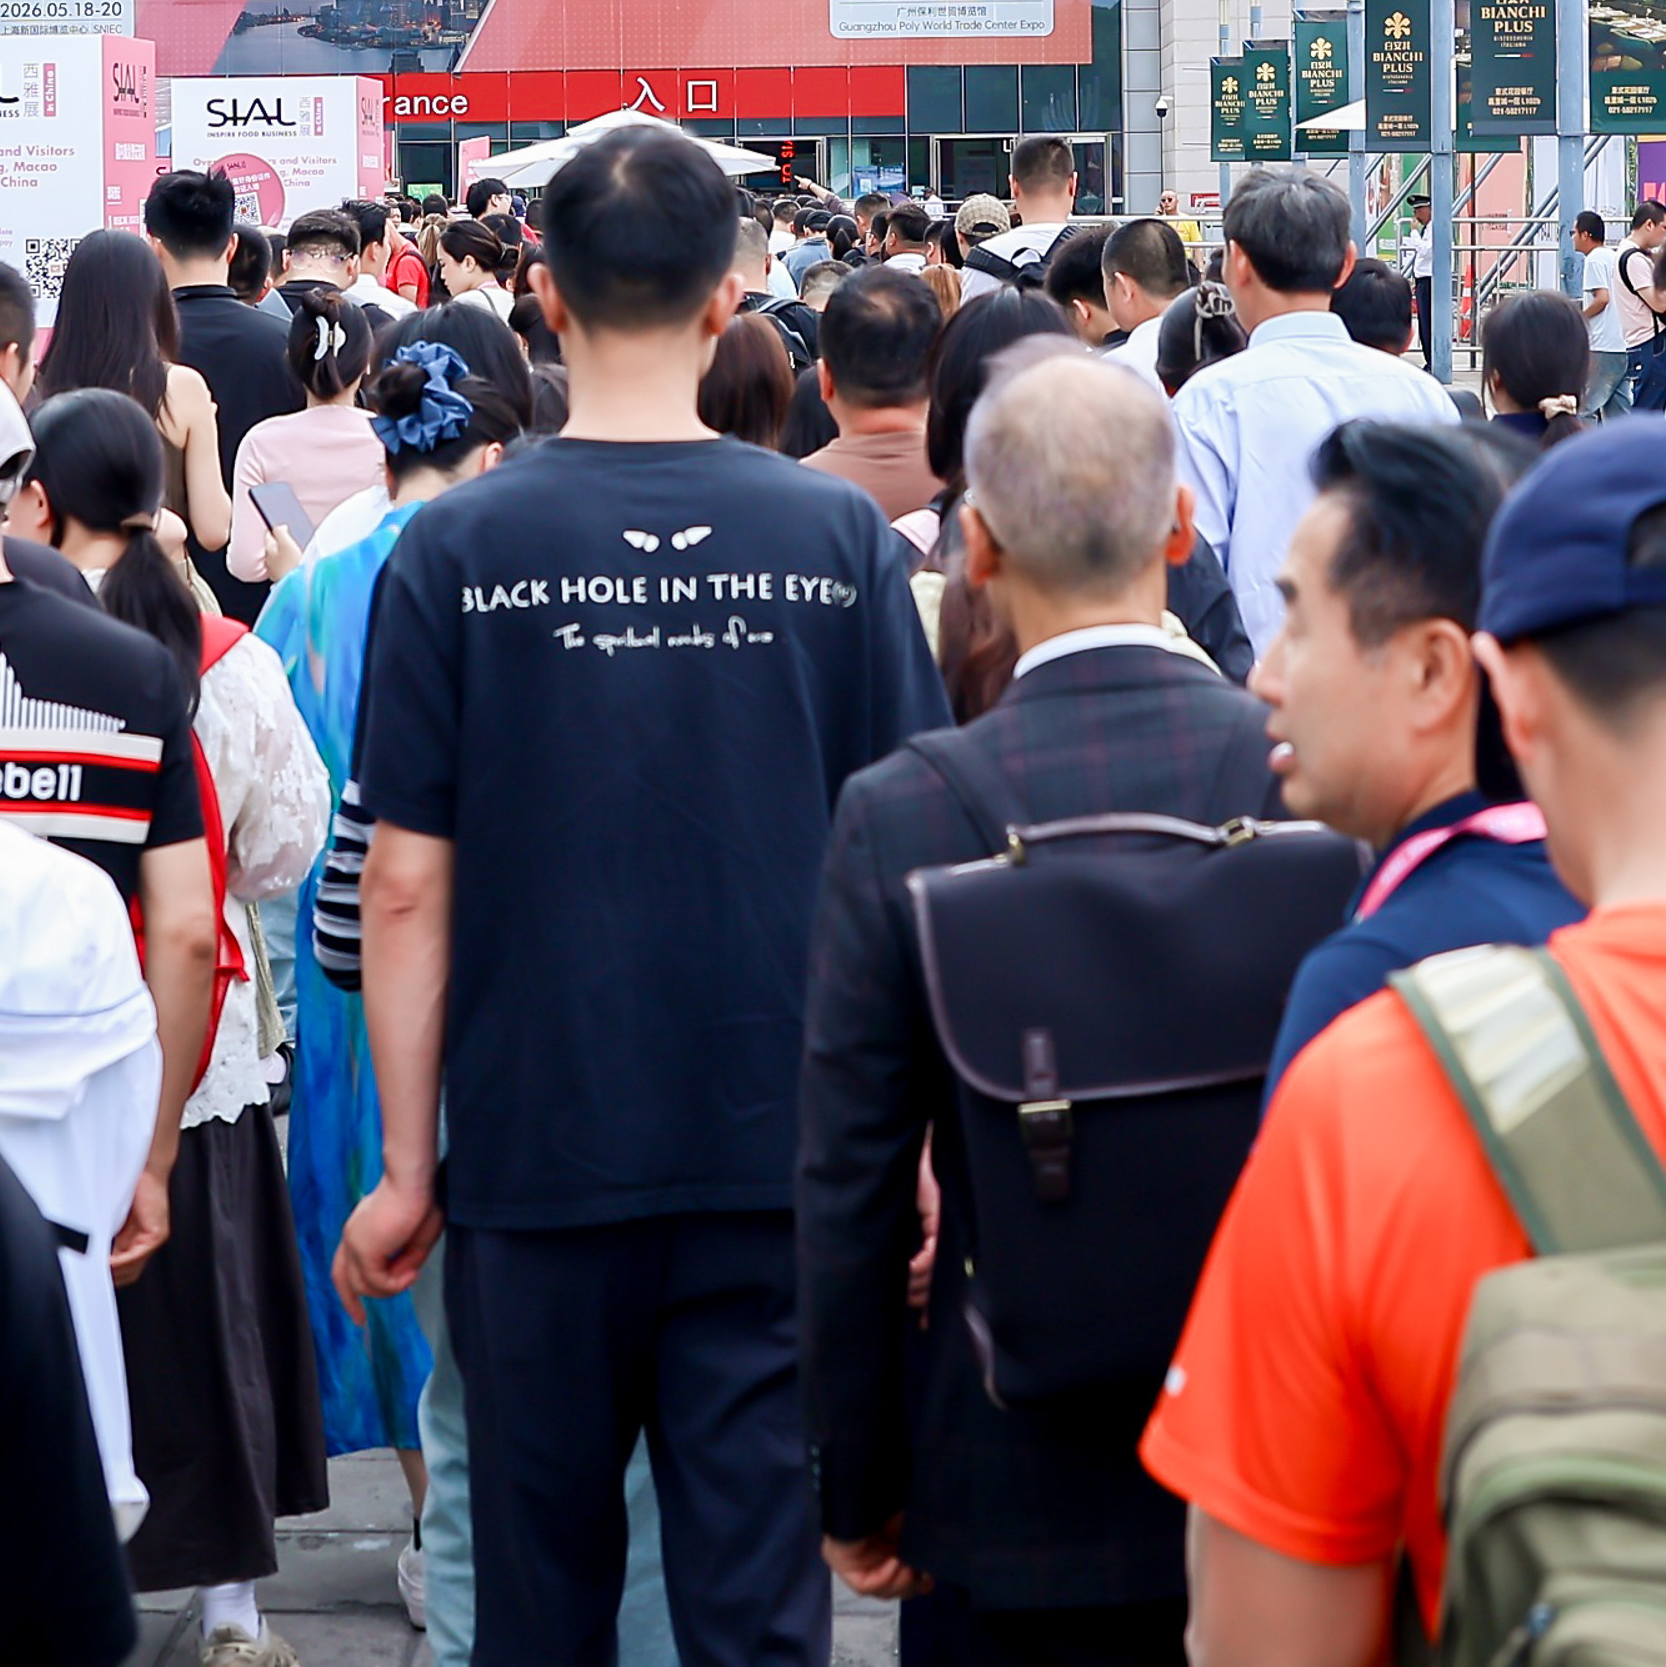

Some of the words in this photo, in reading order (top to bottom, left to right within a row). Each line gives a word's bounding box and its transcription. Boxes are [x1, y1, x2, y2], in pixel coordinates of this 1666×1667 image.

[0, 2, 122, 18] 2026.05.18-20
[1481, 6, 1545, 19] BIANCHI
[93, 25, 122, 34] SNIEC
[839, 21, 896, 33] Guangzhou
[900, 21, 919, 32] Poly
[923, 20, 952, 31] World
[955, 20, 982, 30] Trade
[985, 20, 1017, 30] Center
[1021, 20, 1045, 31] Expo
[1494, 21, 1533, 33] PLUS
[1373, 52, 1423, 62] BIANCHI
[1383, 63, 1413, 72] PLUS
[1302, 70, 1342, 78] BIANCHI
[46, 70, 55, 102] China
[1310, 79, 1335, 87] PLUS
[23, 63, 40, 117] 西雅展
[629, 76, 718, 112] 入口
[206, 98, 297, 127] SIAL
[26, 145, 75, 156] Visitors
[13, 162, 57, 172] Macao
[0, 177, 38, 188] China
[0, 239, 13, 248] pay
[461, 579, 550, 614] BLACK
[561, 576, 648, 604] HOLE
[660, 577, 697, 603] IN
[706, 573, 773, 600] THE
